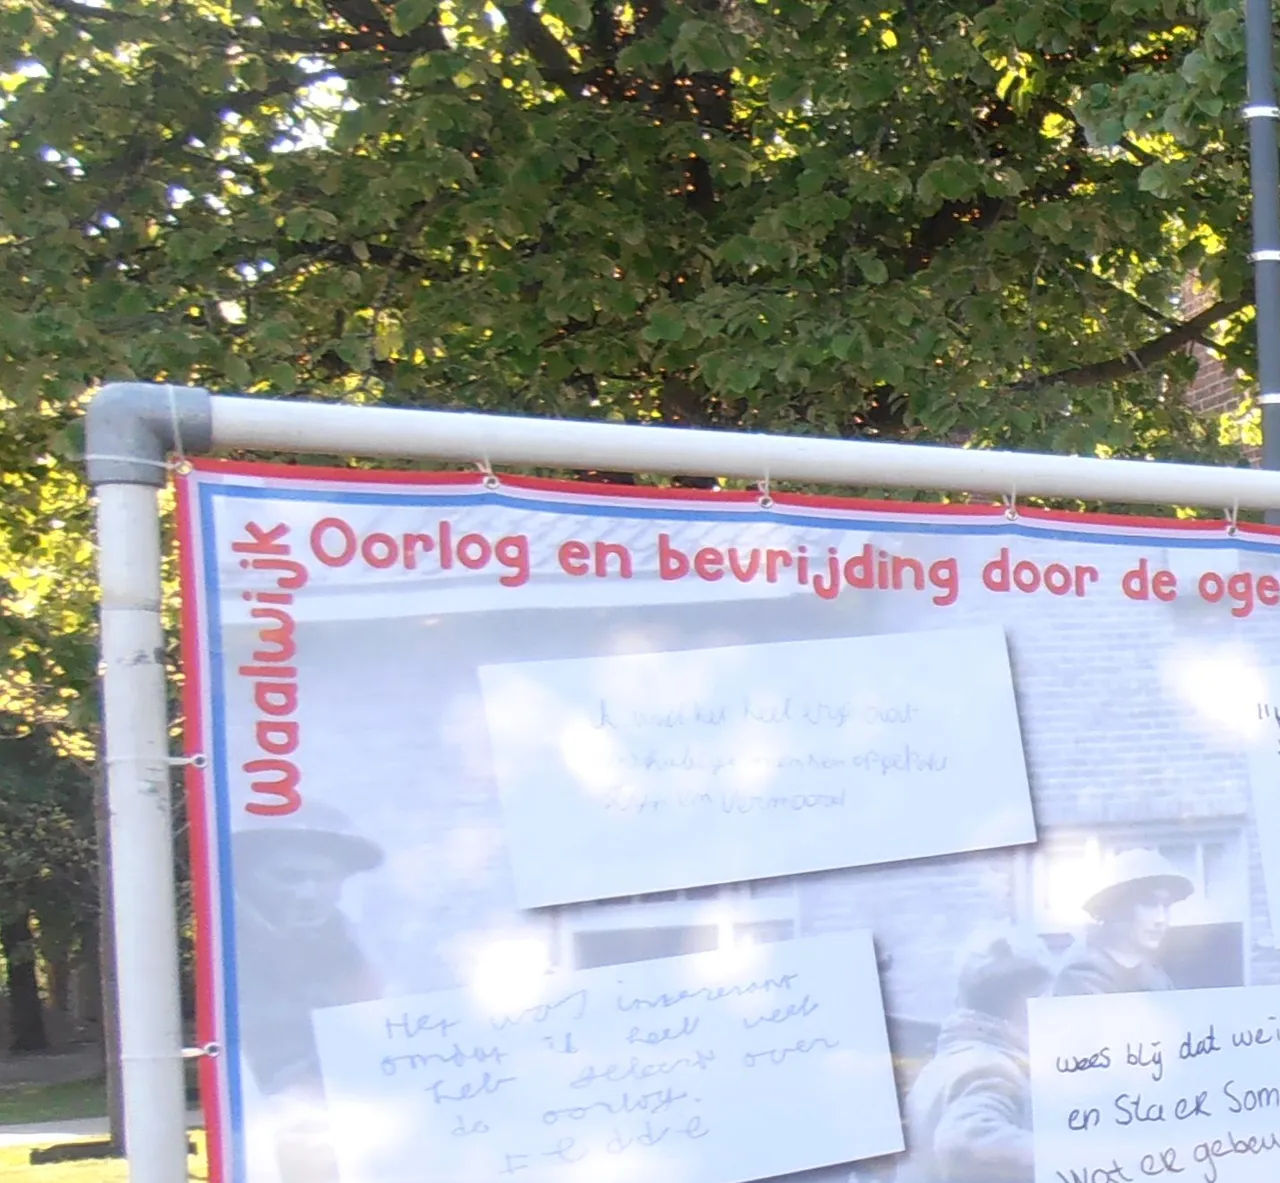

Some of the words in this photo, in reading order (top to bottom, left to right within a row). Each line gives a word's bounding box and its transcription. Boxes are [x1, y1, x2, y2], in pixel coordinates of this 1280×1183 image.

[309, 516, 531, 588] Oorlog
[557, 539, 633, 579] en
[657, 534, 960, 607] bevrijding
[981, 549, 1098, 596] door
[1121, 558, 1178, 603] de
[231, 520, 309, 817] Waalwijk
[1178, 1023, 1222, 1060] dat
[1231, 1027, 1272, 1048] we
[1066, 1106, 1100, 1132] en
